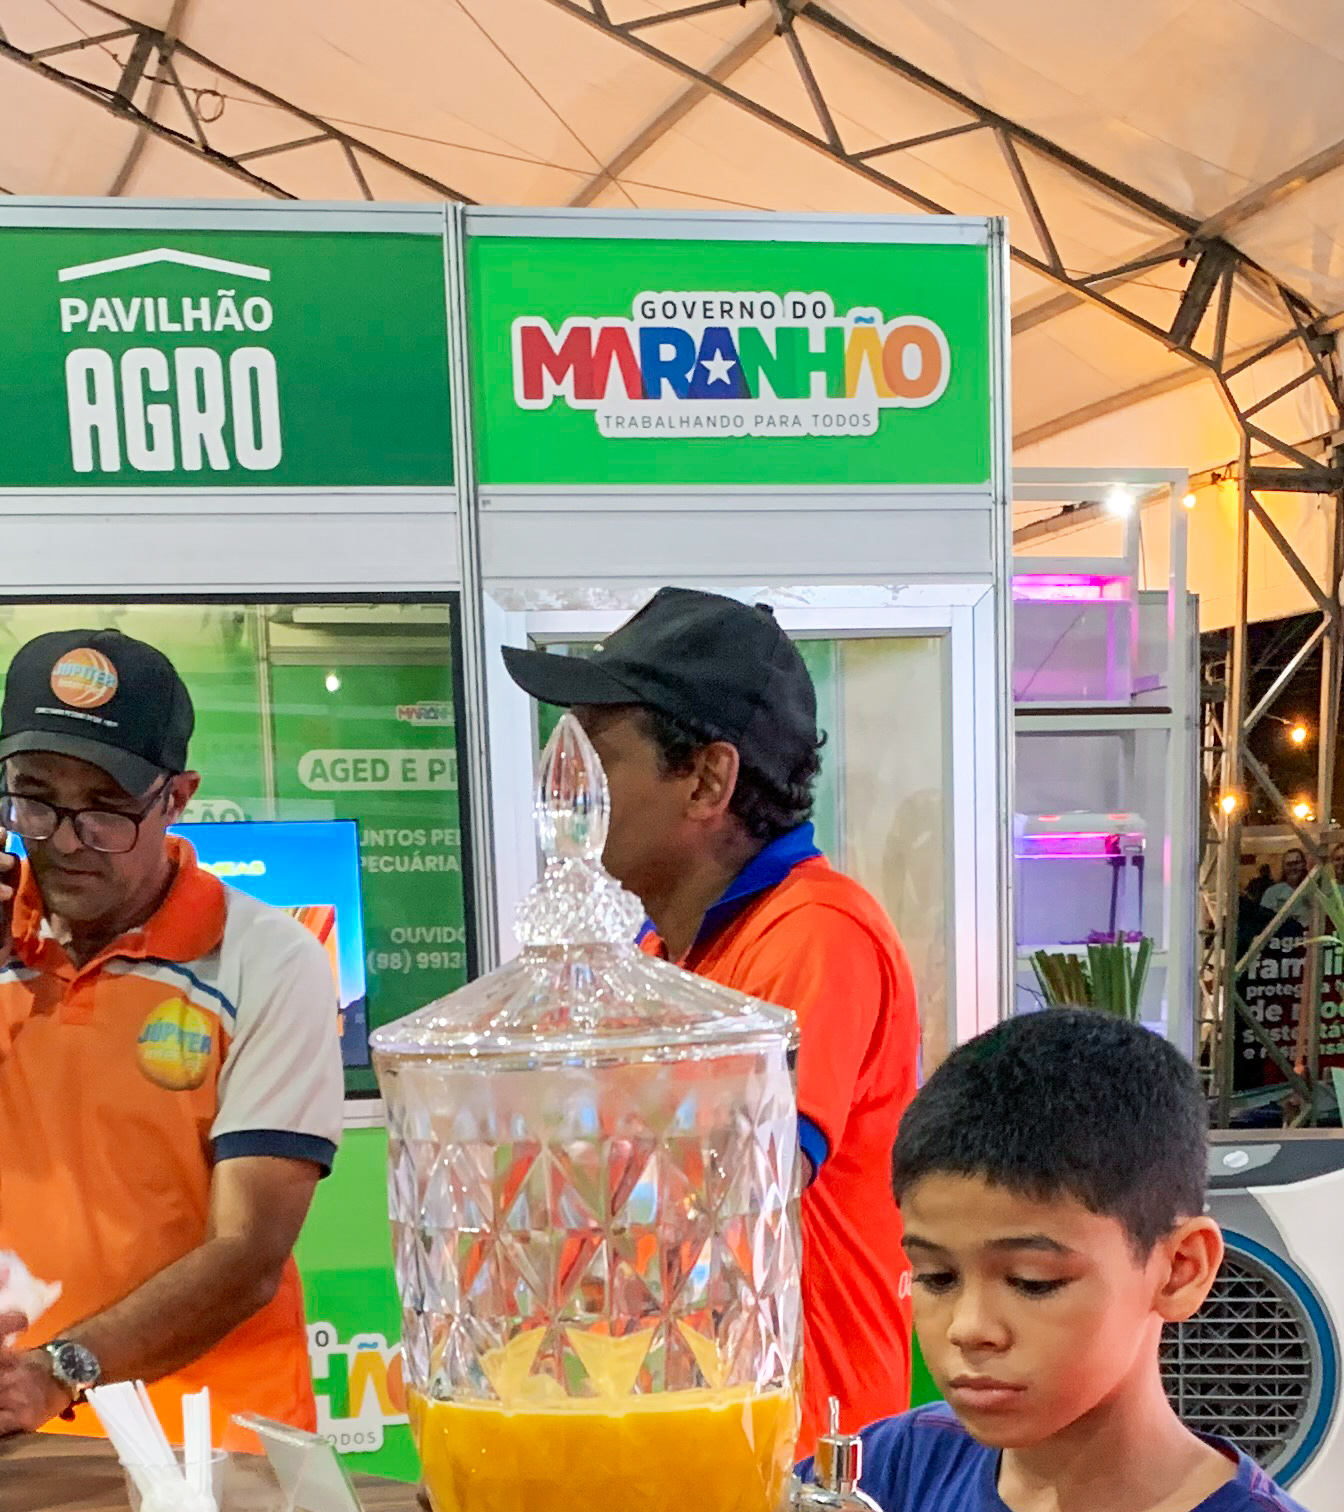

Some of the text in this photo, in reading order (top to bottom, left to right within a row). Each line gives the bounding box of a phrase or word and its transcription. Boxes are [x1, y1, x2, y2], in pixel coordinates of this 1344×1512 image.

[59, 288, 274, 333] PAVILHÃO
[640, 299, 828, 321] GOVERNO DO
[520, 315, 943, 400] MARANHÃO
[64, 346, 283, 473] AGRO
[604, 412, 872, 429] TRABALHANDO PARA TODOS
[309, 757, 390, 783] AGED
[401, 757, 418, 783] E
[366, 949, 466, 974] (98) 9913
